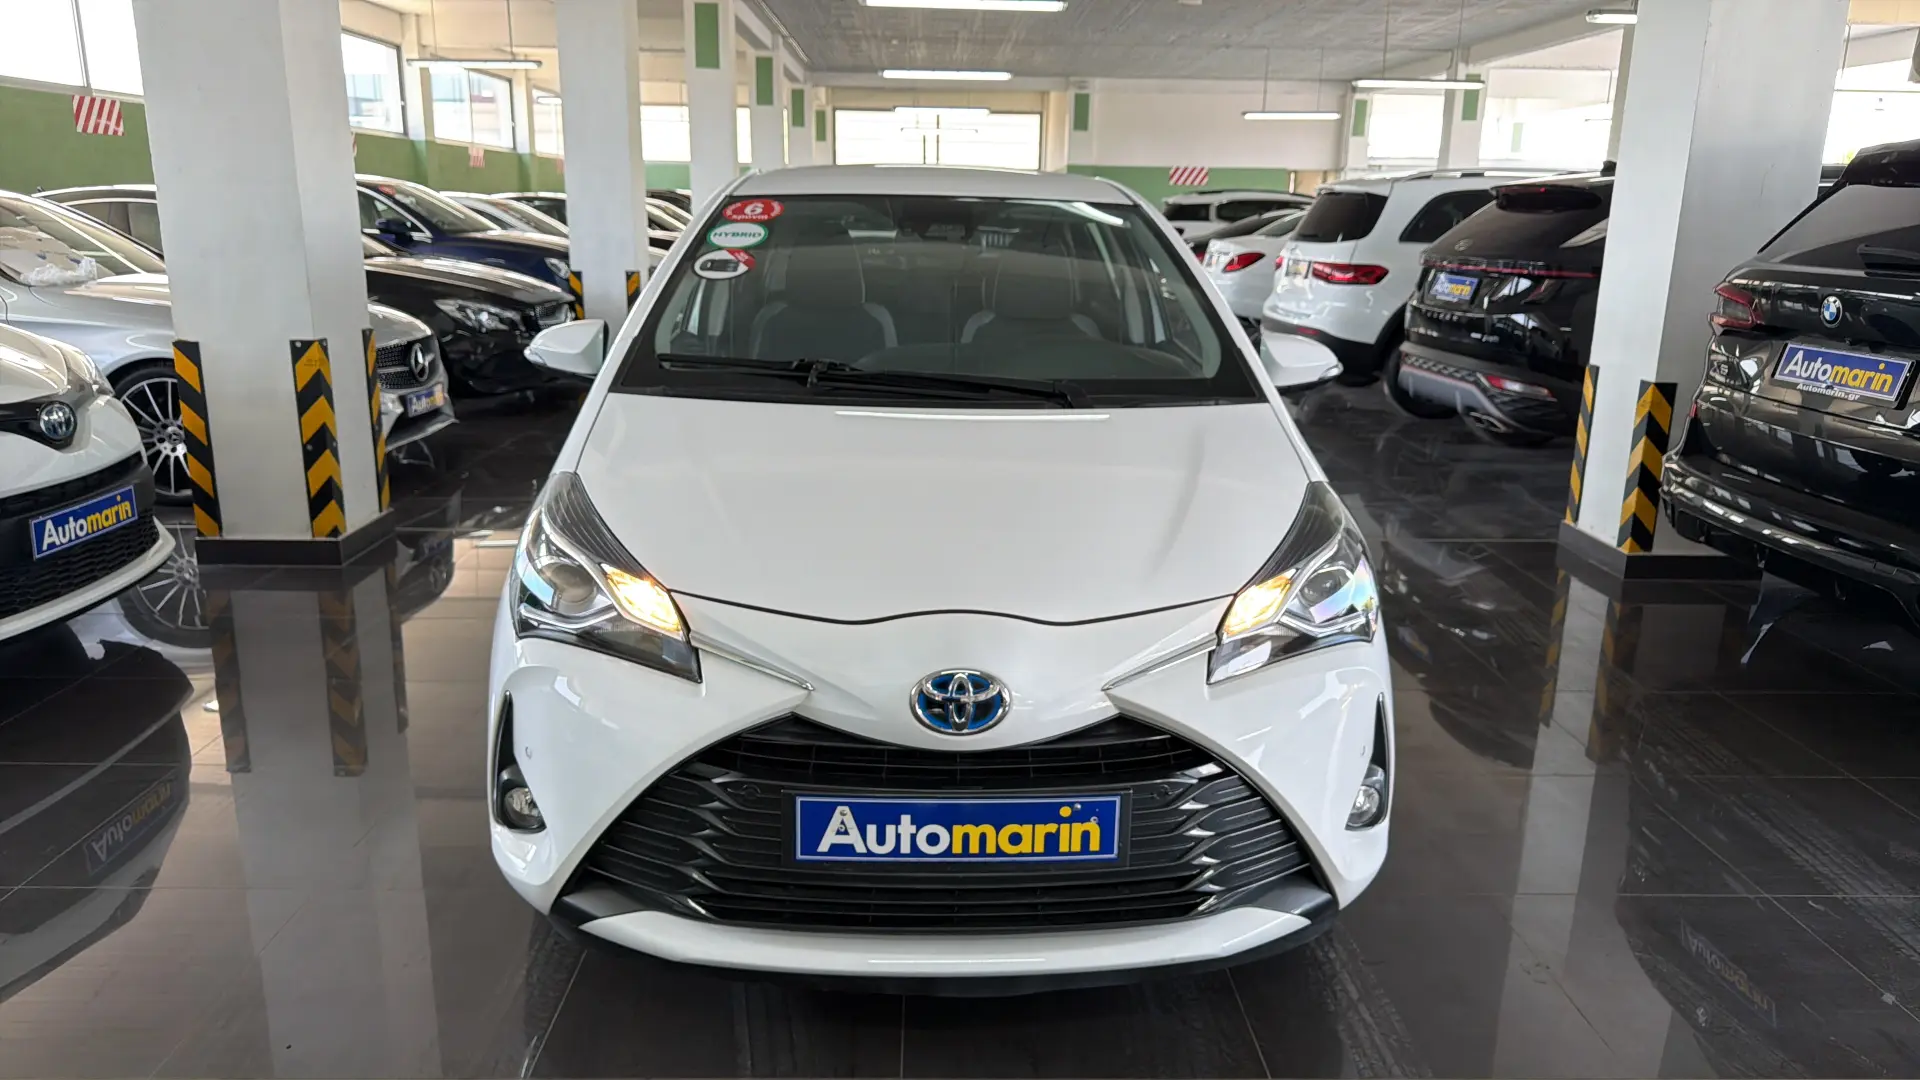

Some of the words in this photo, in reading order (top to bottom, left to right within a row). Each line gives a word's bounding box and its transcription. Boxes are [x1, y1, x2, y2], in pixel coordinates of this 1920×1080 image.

[744, 202, 765, 216] 6
[713, 231, 762, 239] HYBRID
[1784, 350, 1893, 392] Automarin
[1796, 383, 1860, 400] Automarin.gr
[42, 495, 132, 551] Automarin
[816, 806, 1101, 855] Automarin
